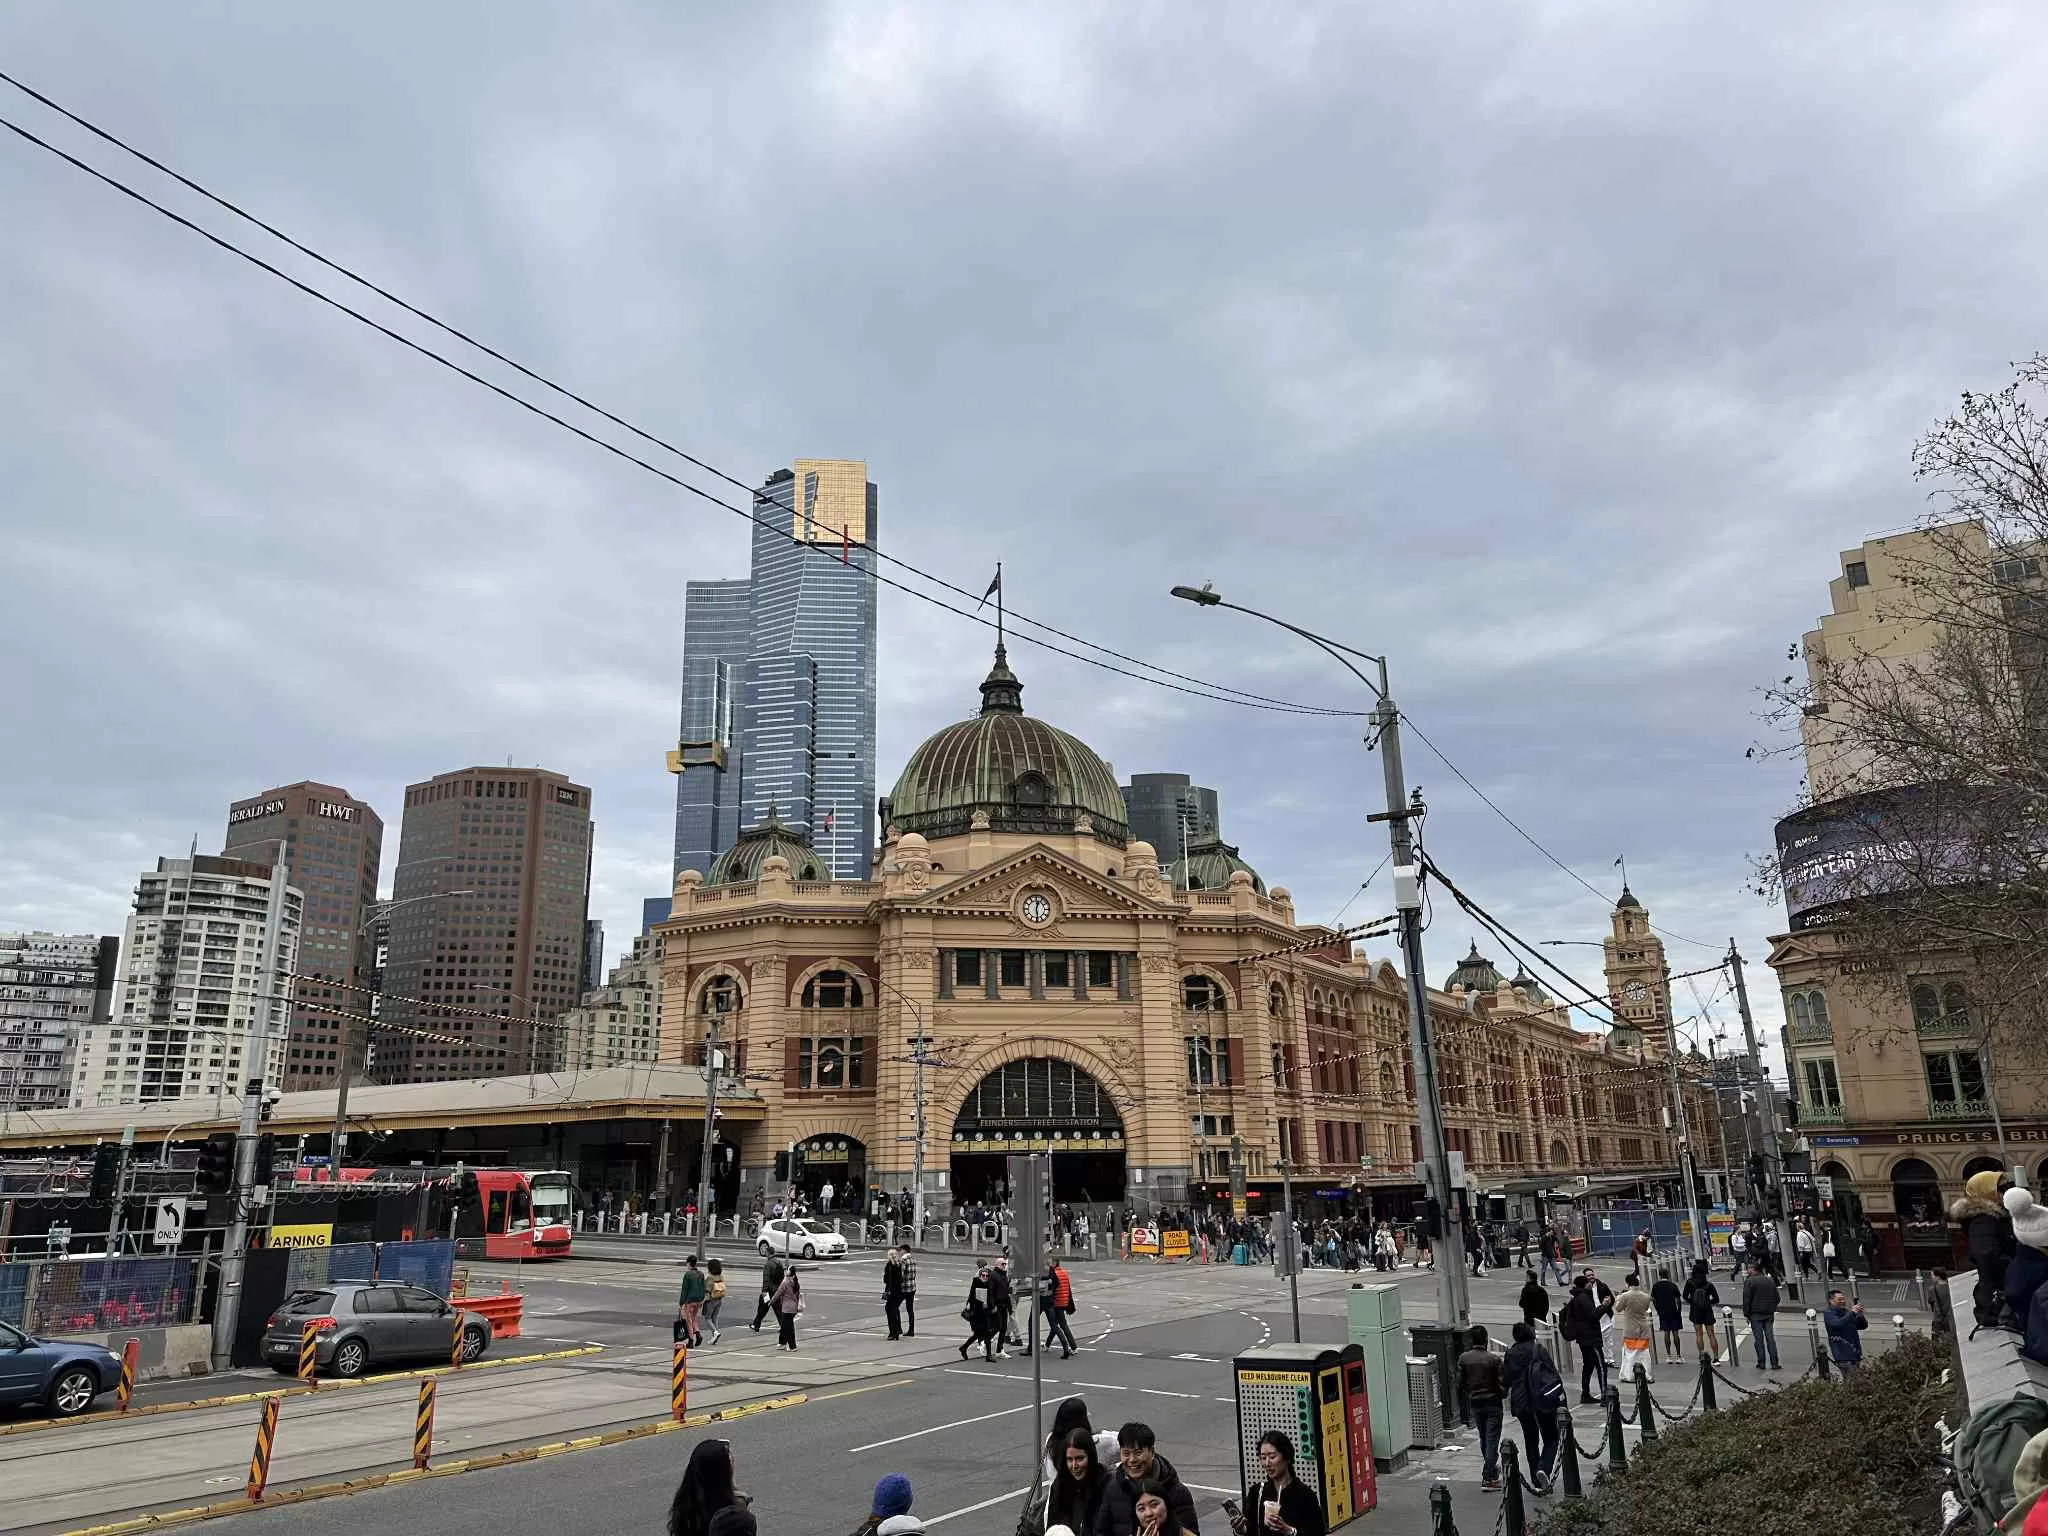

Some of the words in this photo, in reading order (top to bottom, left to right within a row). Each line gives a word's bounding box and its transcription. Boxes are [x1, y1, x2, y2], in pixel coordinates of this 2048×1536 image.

[266, 801, 285, 814] SUN
[319, 802, 354, 820] HWT
[1064, 1118, 1099, 1126] STATION
[158, 1230, 180, 1239] ONLY
[271, 1234, 325, 1248] ARNING
[1240, 1372, 1254, 1380] KEEP
[1256, 1373, 1289, 1381] MELBOURNE
[1290, 1374, 1309, 1382] CLEAN
